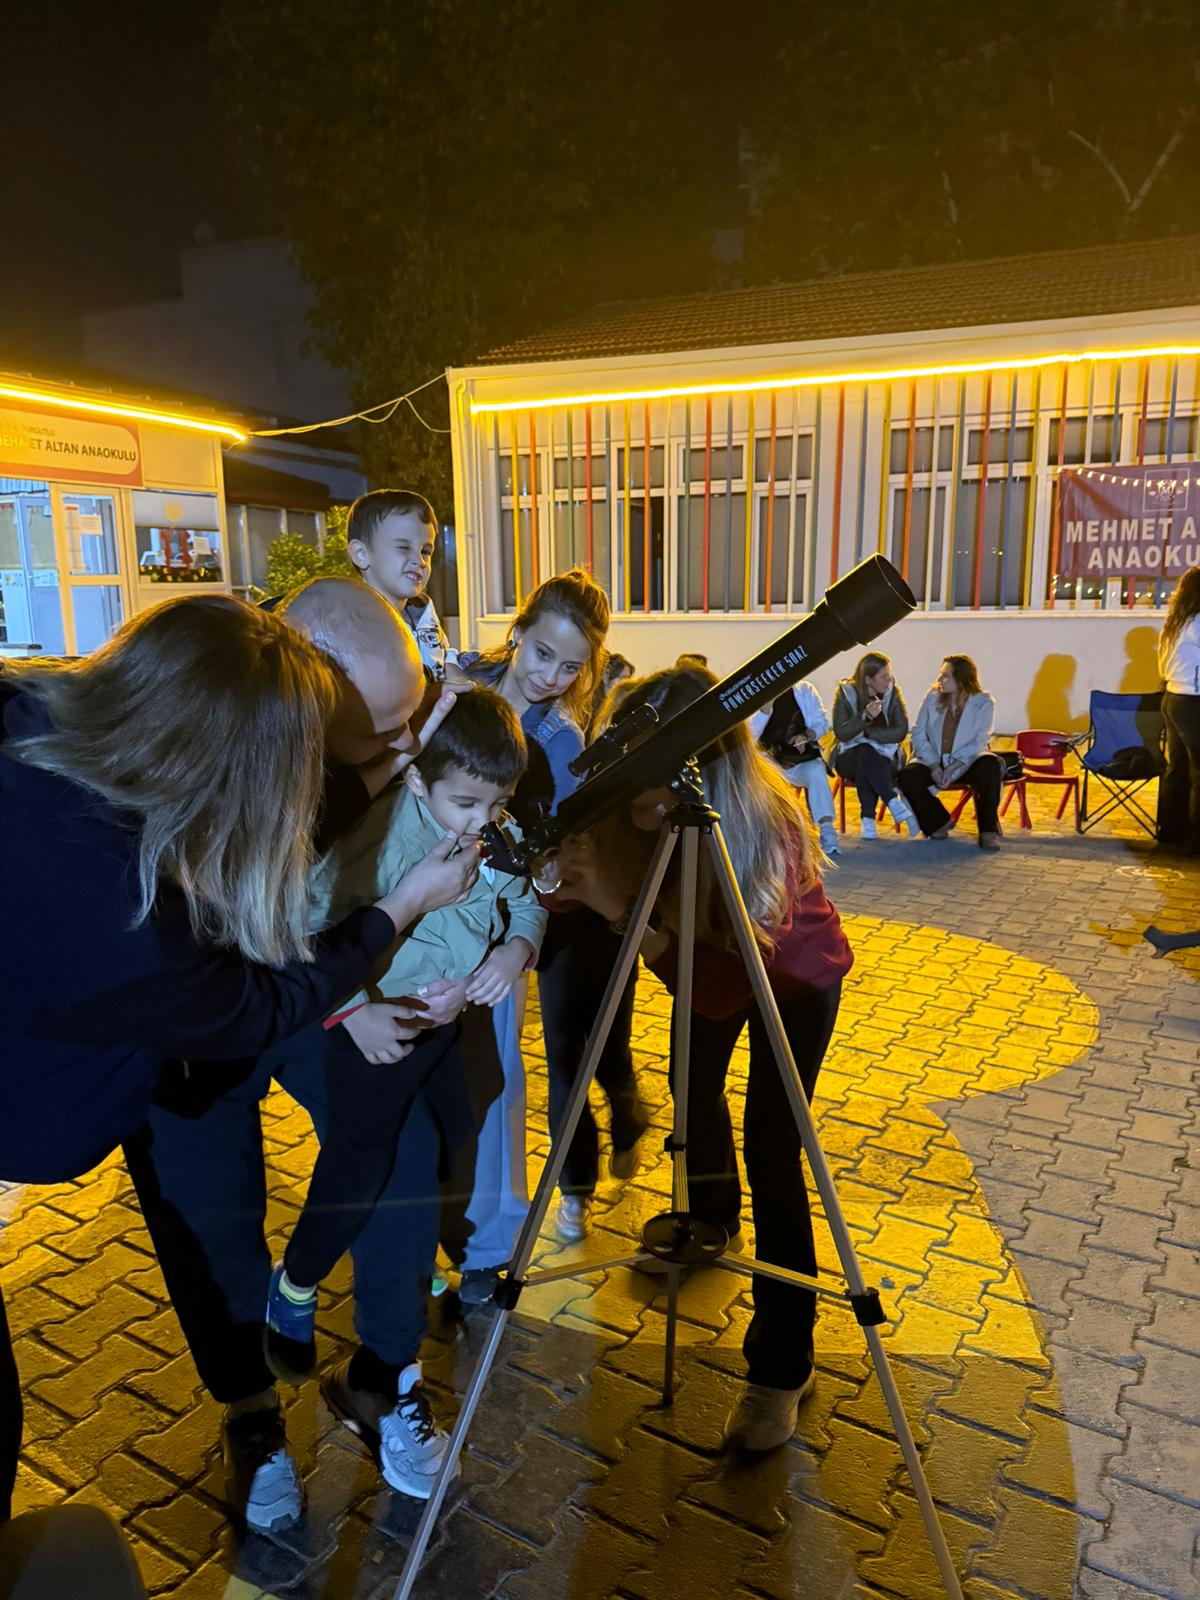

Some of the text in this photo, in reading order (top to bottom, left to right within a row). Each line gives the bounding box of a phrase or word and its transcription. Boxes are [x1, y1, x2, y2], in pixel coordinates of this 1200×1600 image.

[45, 440, 79, 455] ALTAN
[81, 445, 136, 461] ANAOKULU
[1066, 518, 1172, 543] MEHMET
[1087, 544, 1200, 568] ANAOKU
[722, 661, 785, 713] POWERSEEKER
